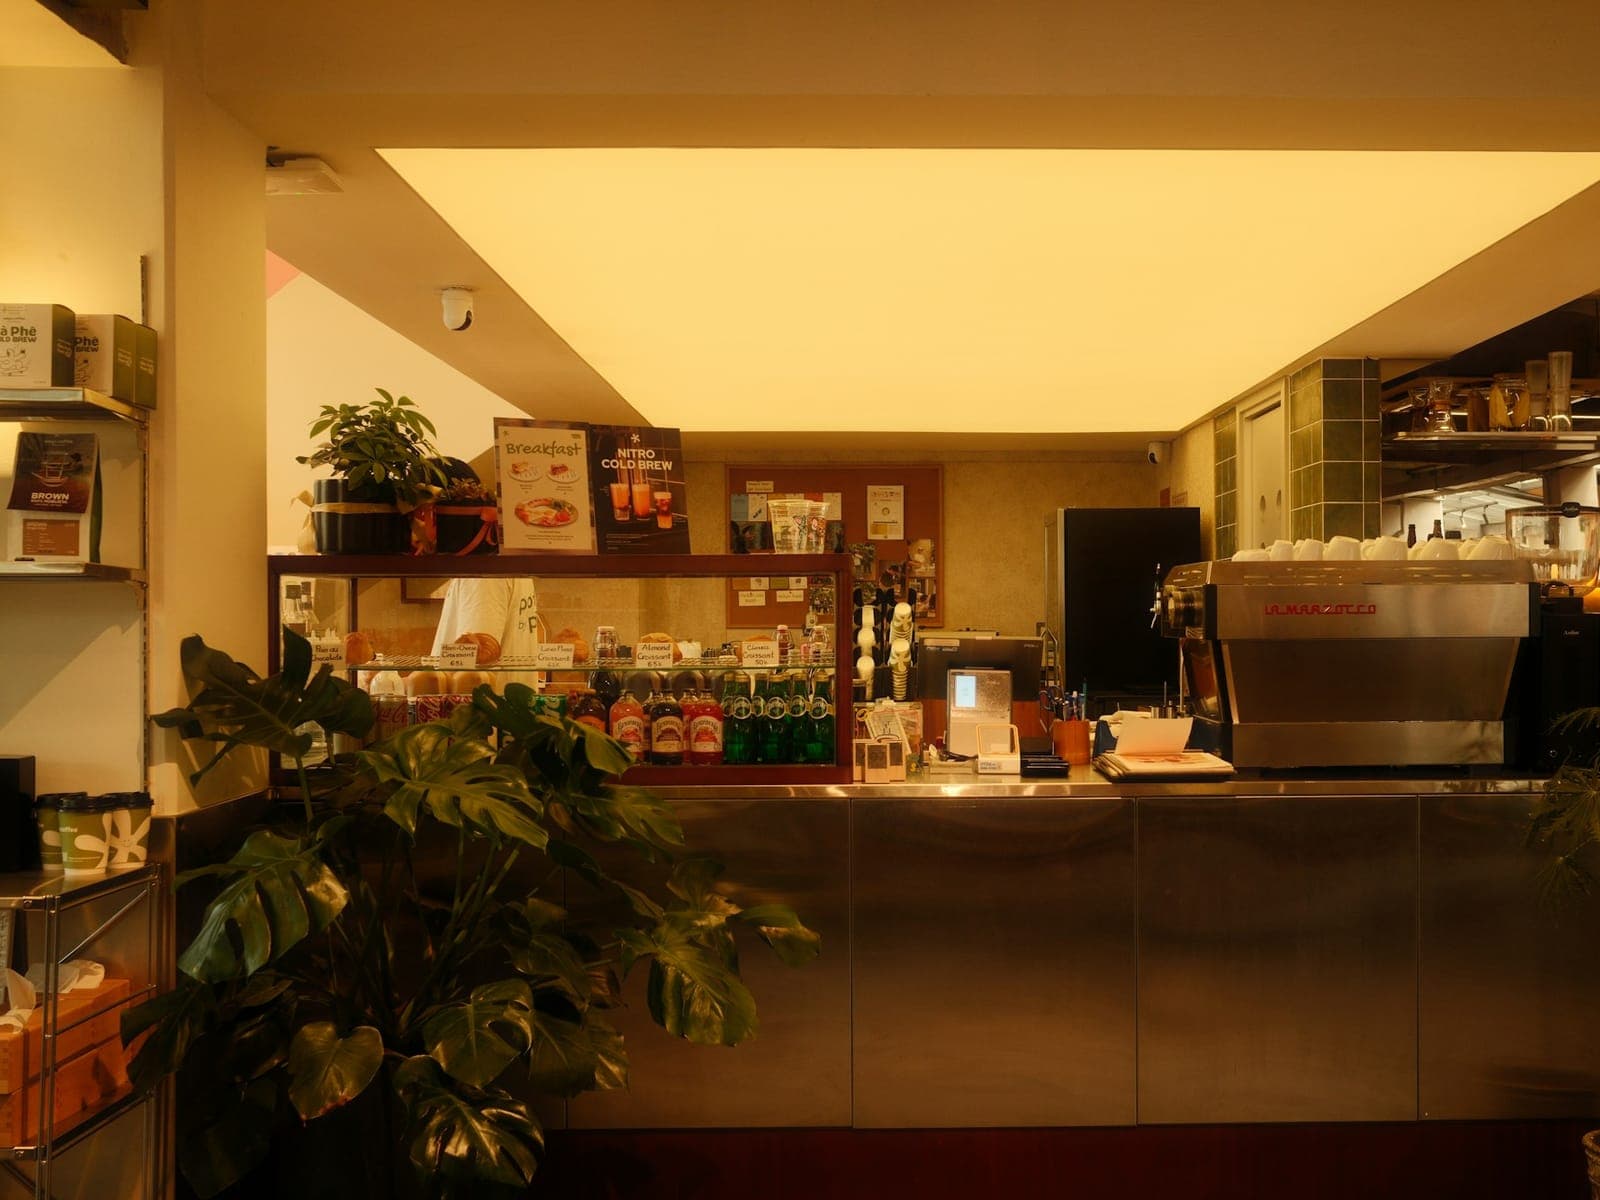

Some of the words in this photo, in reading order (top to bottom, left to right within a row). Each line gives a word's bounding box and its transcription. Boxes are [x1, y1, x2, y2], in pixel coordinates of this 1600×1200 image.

[506, 441, 582, 458] Breakfast
[617, 448, 656, 459] NITRO
[601, 459, 636, 470] COLD
[638, 460, 673, 471] BREW
[31, 492, 70, 500] BROWN
[641, 643, 671, 651] Almond
